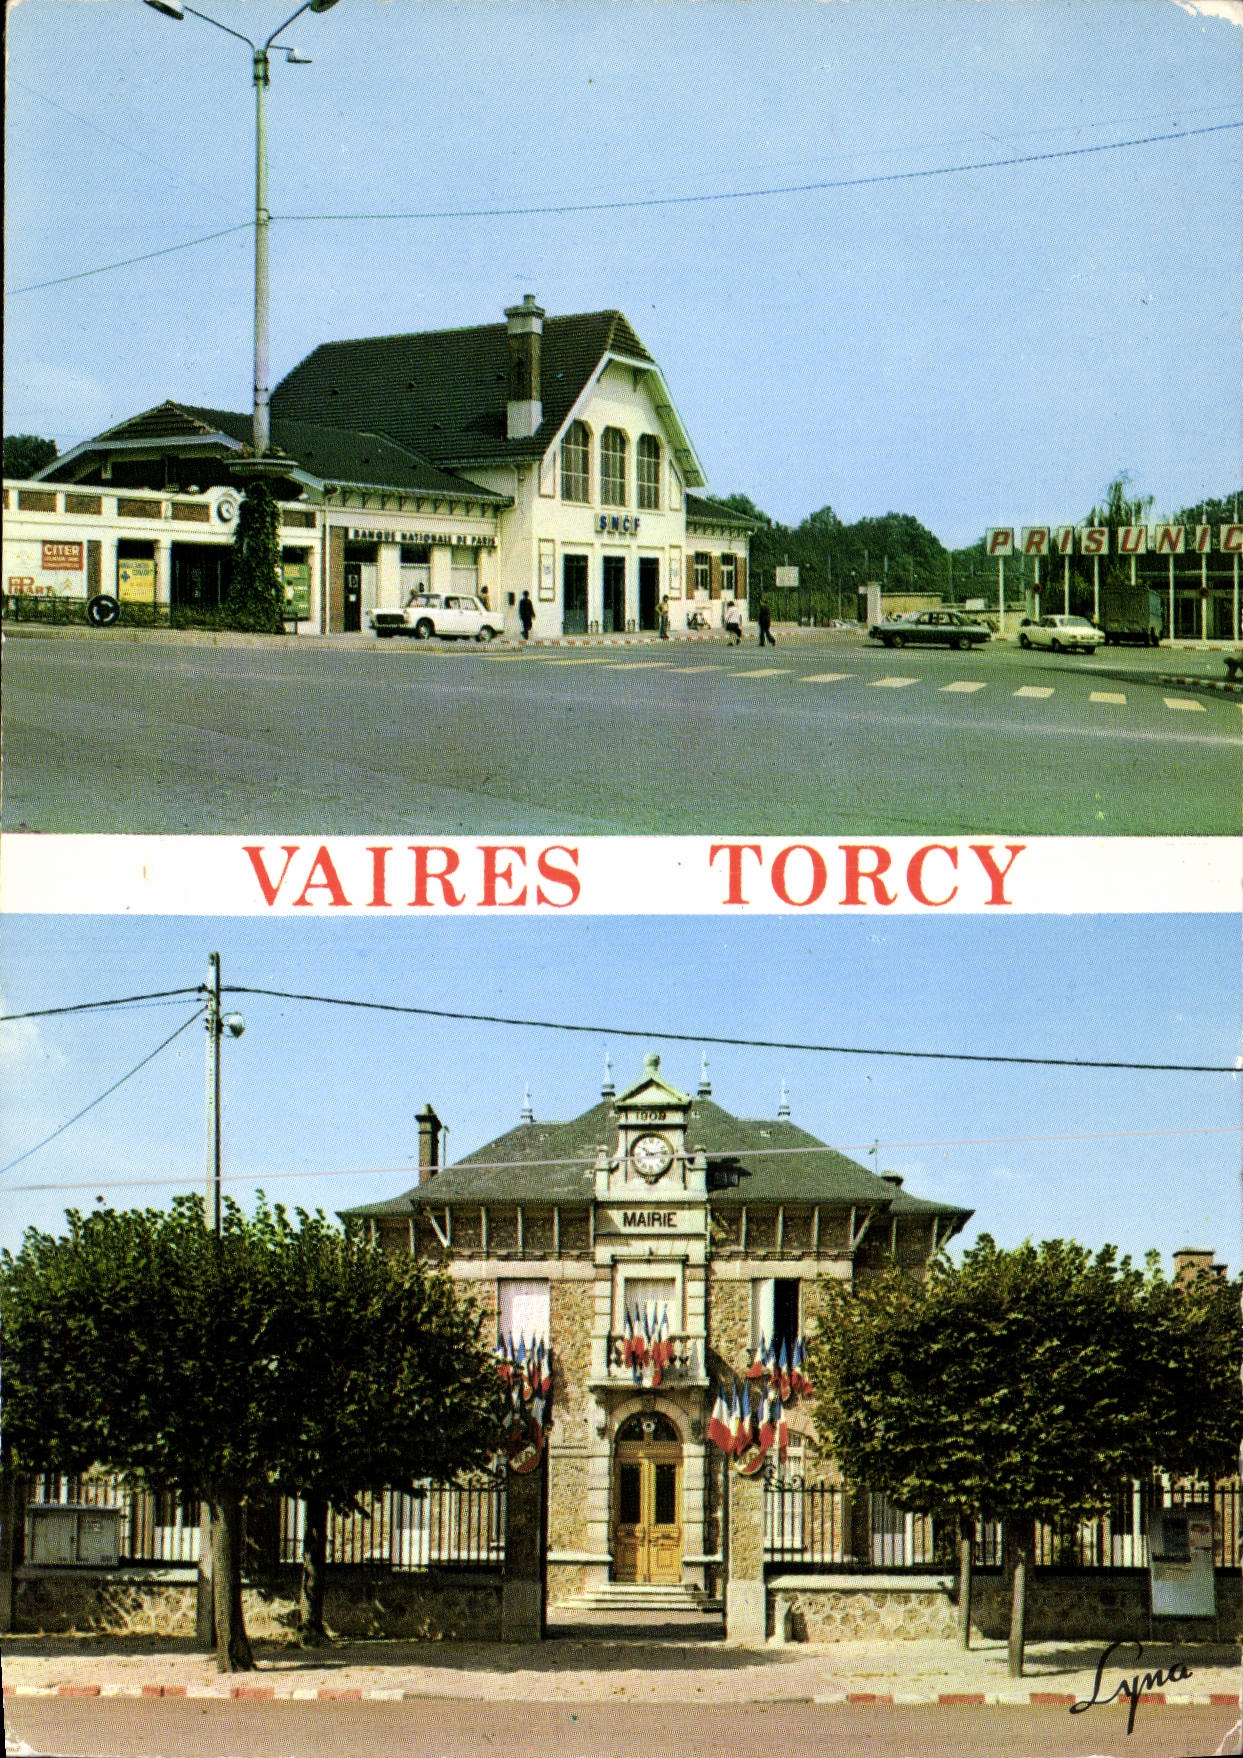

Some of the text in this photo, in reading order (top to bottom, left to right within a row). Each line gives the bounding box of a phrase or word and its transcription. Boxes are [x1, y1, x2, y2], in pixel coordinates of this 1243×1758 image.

[598, 515, 641, 532] SNCF
[353, 528, 496, 547] BANQUE NATIONALE DE PARIS
[989, 526, 1243, 553] PRISUNIC
[44, 543, 81, 555] CITER
[622, 1212, 678, 1228] MAIRIE
